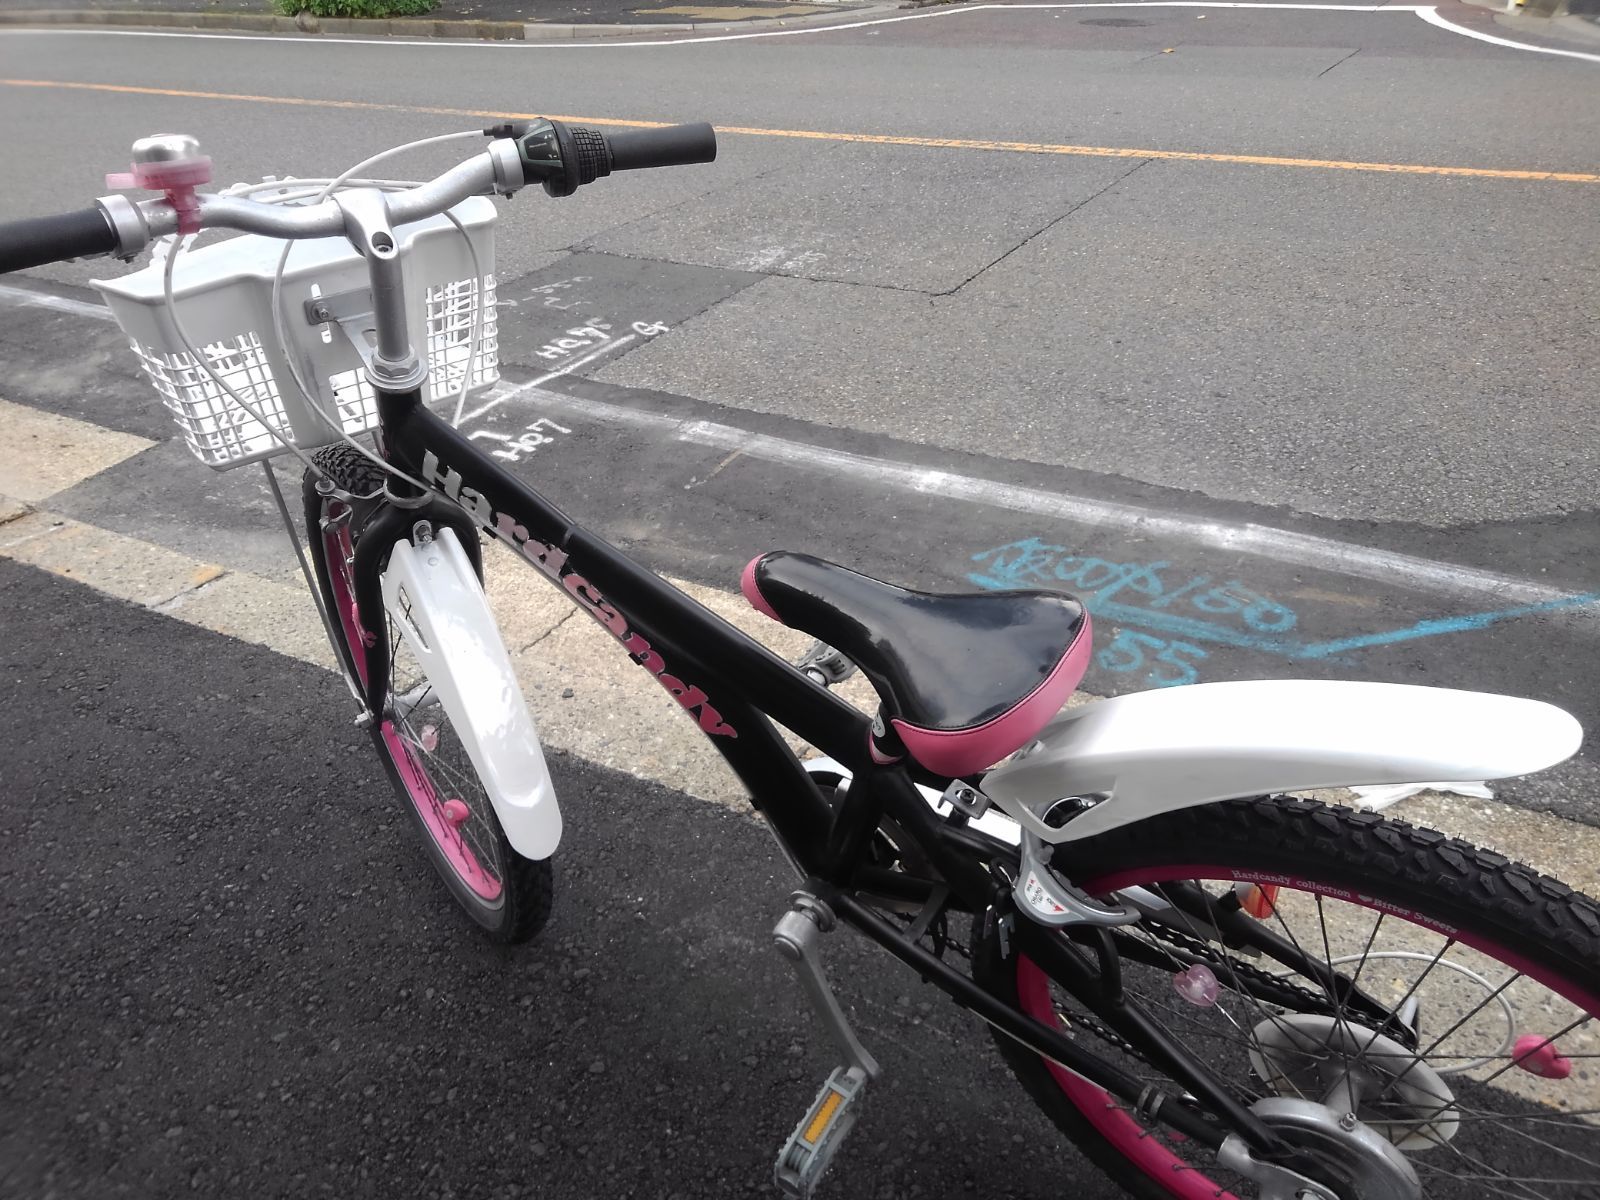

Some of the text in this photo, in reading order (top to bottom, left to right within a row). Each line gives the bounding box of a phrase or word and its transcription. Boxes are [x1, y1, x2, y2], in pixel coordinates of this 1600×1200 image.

[1231, 869, 1291, 885] Hardcandy
[1296, 879, 1351, 898] collection
[1373, 898, 1411, 916] Bitter
